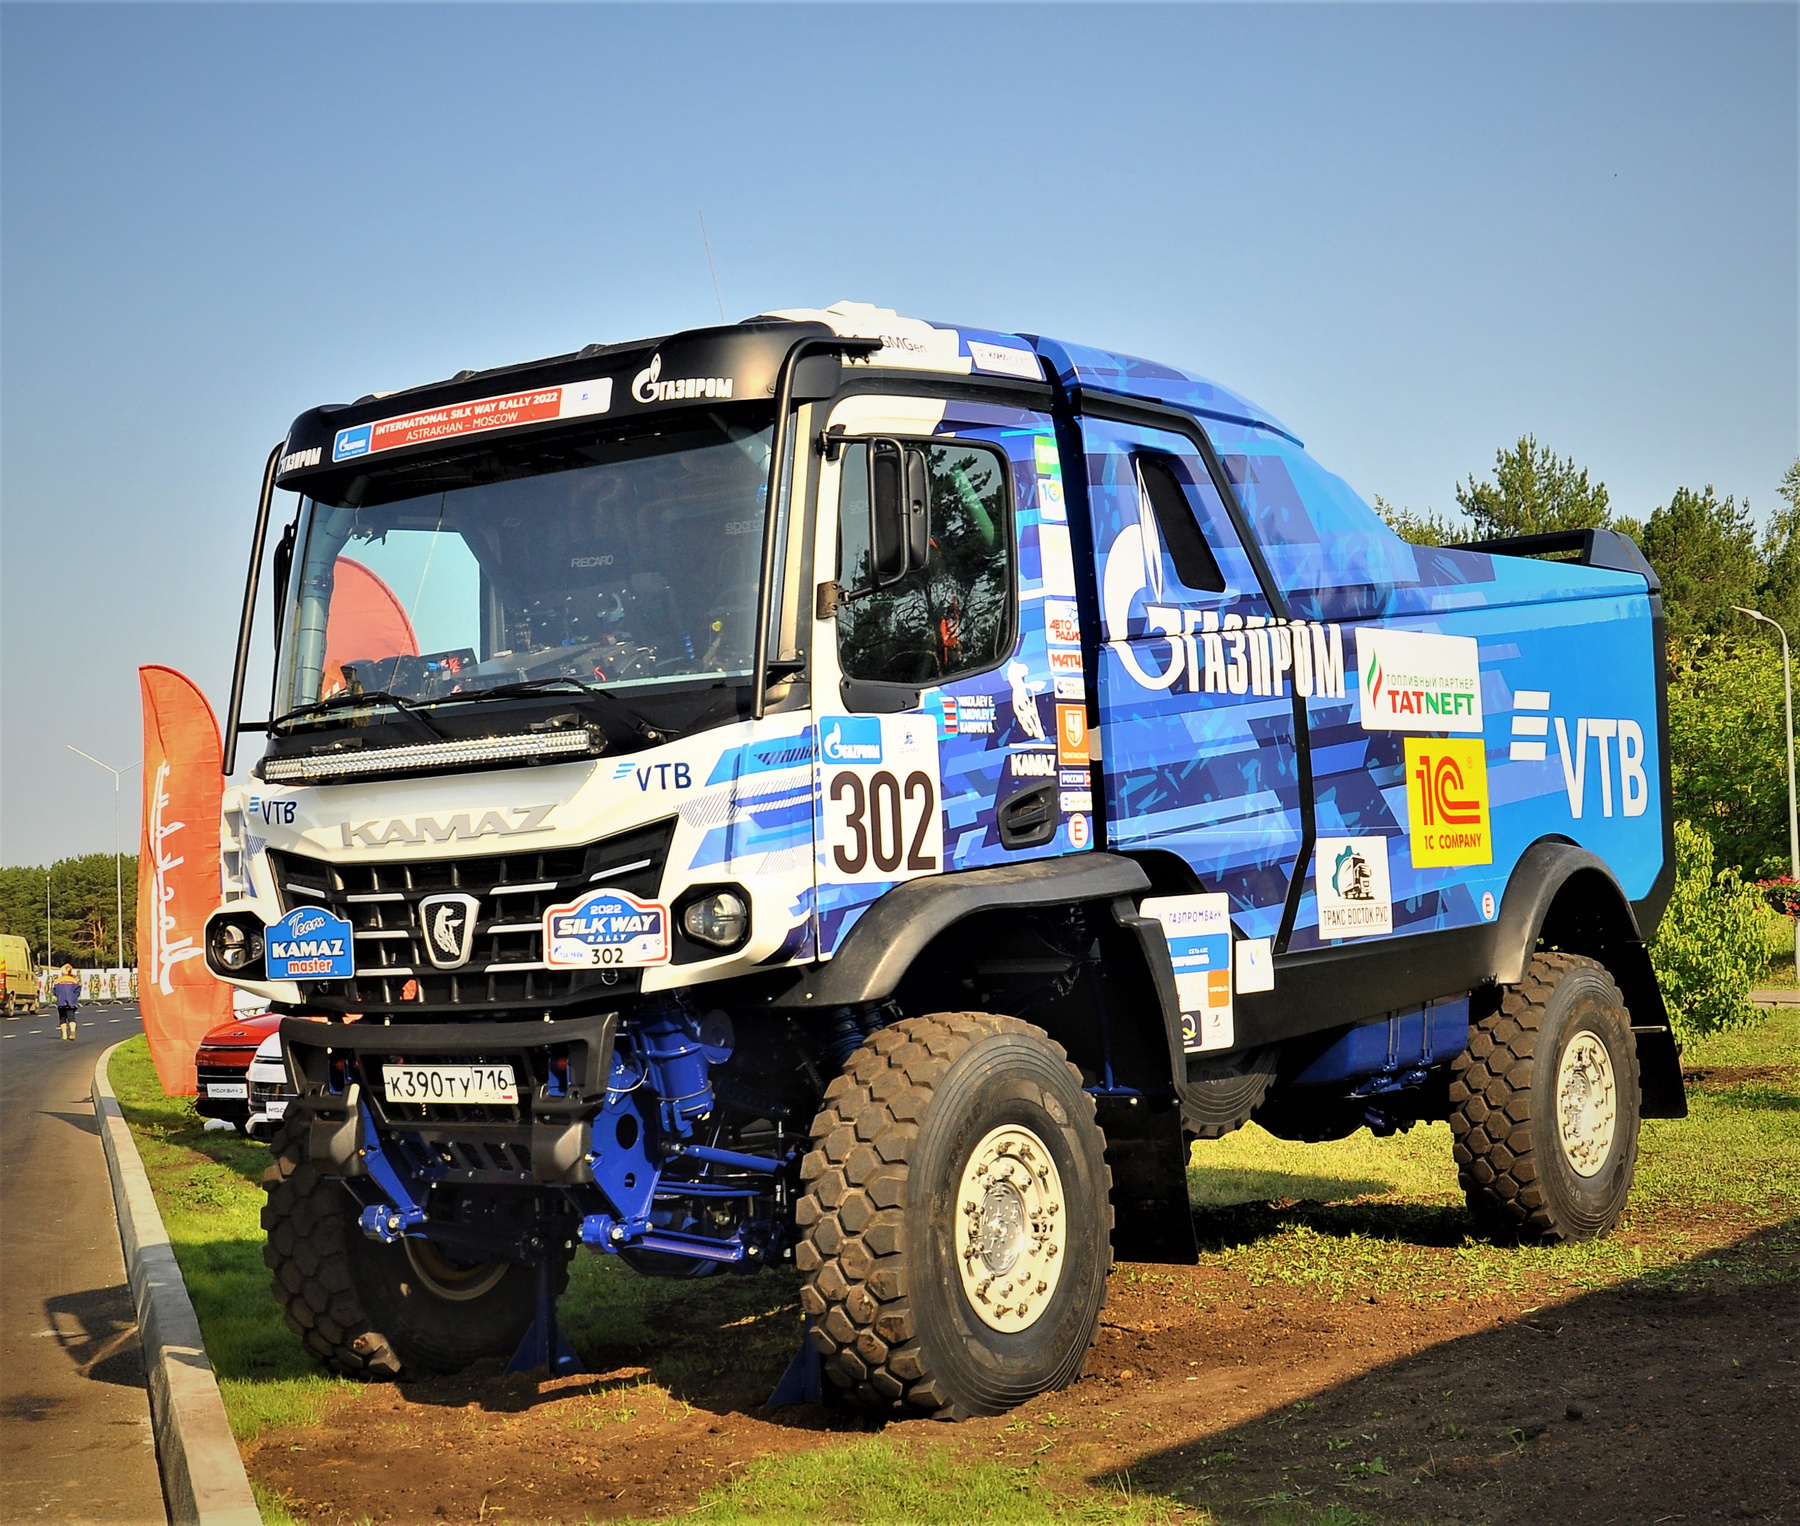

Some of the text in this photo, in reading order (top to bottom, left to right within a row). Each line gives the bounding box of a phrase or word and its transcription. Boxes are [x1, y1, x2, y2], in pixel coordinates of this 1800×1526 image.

[375, 391, 558, 436] INTERNATIONAL SILK WAY RALLY 2022
[405, 420, 463, 442] ASTRAKHAN
[472, 411, 519, 429] MOSCOW
[571, 554, 614, 568] RECARO
[1049, 619, 1072, 630] АВТО
[1386, 673, 1475, 690] ТОПЛИВНЫЙ ПАРТНЕР
[1387, 690, 1475, 716] TATNEFT
[1010, 753, 1057, 777] KAMAZ
[1554, 717, 1648, 819] VTB
[636, 762, 693, 792] VTB
[261, 800, 297, 826] VTB
[830, 770, 937, 875] 302
[341, 804, 557, 849] KAMAZ
[1438, 832, 1482, 850] COMPANY
[589, 904, 623, 916] 2022
[1323, 905, 1388, 927] ТРАКС ВОСТОК РУС
[288, 912, 326, 939] Team
[557, 914, 657, 936] SILK WAY
[271, 939, 345, 959] KAMAZ
[586, 933, 628, 943] RALLY
[288, 958, 333, 974] master
[591, 947, 624, 965] 302
[474, 1069, 508, 1091] 716
